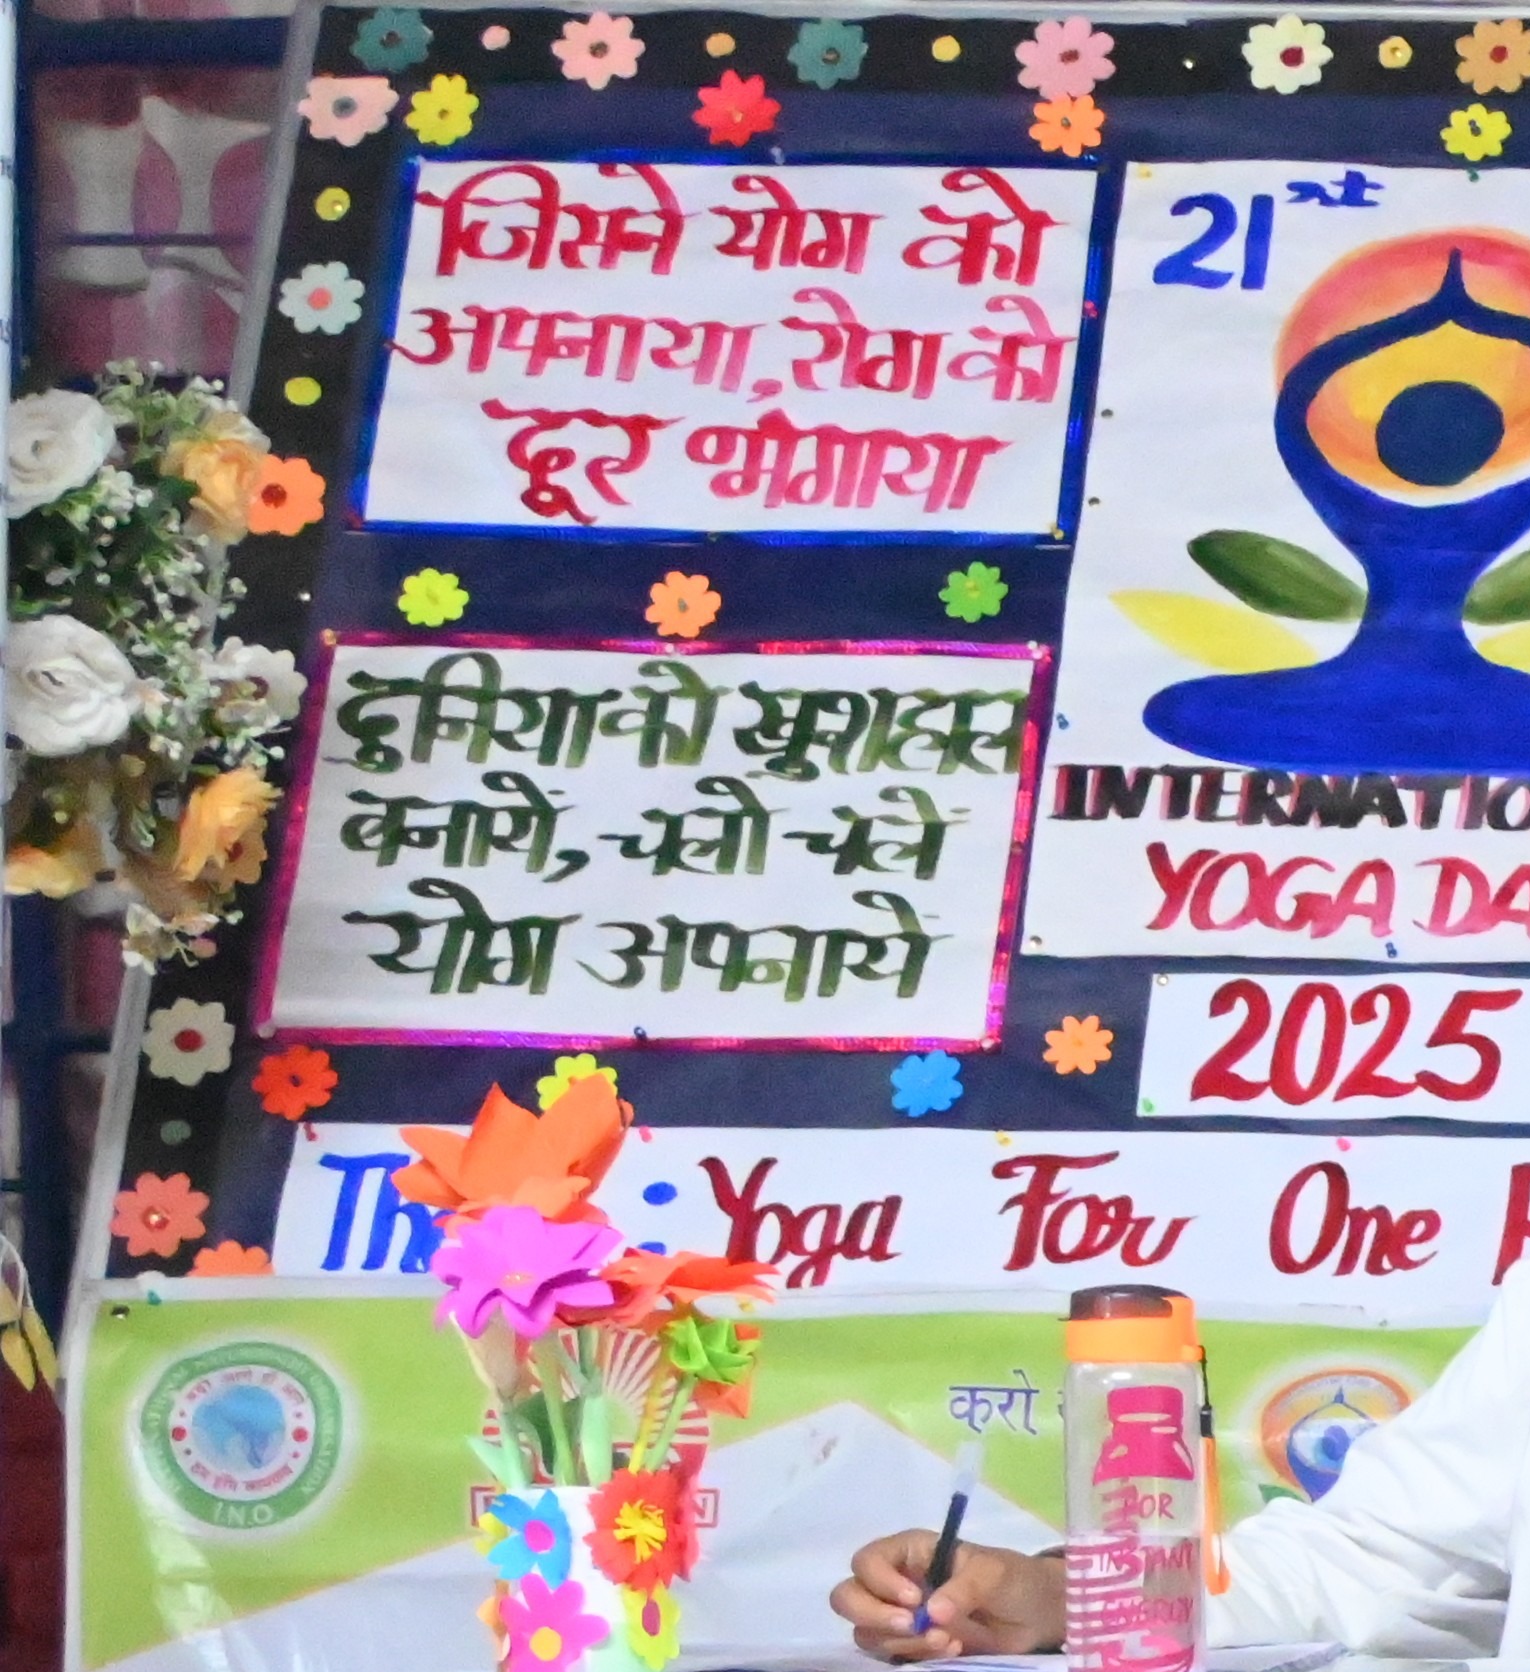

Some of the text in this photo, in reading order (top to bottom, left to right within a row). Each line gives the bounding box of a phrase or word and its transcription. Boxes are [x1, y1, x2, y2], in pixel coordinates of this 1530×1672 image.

[415, 161, 1070, 285] जिसने योग को
[947, 294, 1077, 403] को
[481, 399, 690, 525] दूर
[598, 776, 790, 876] चलो
[341, 879, 582, 998] योग
[1145, 840, 1396, 939] YOGA
[1190, 979, 1522, 1106] 2025
[697, 1156, 903, 1289] Yoga
[991, 1150, 1199, 1272] For
[1267, 1160, 1443, 1277] One
[949, 1369, 1039, 1435] करो
